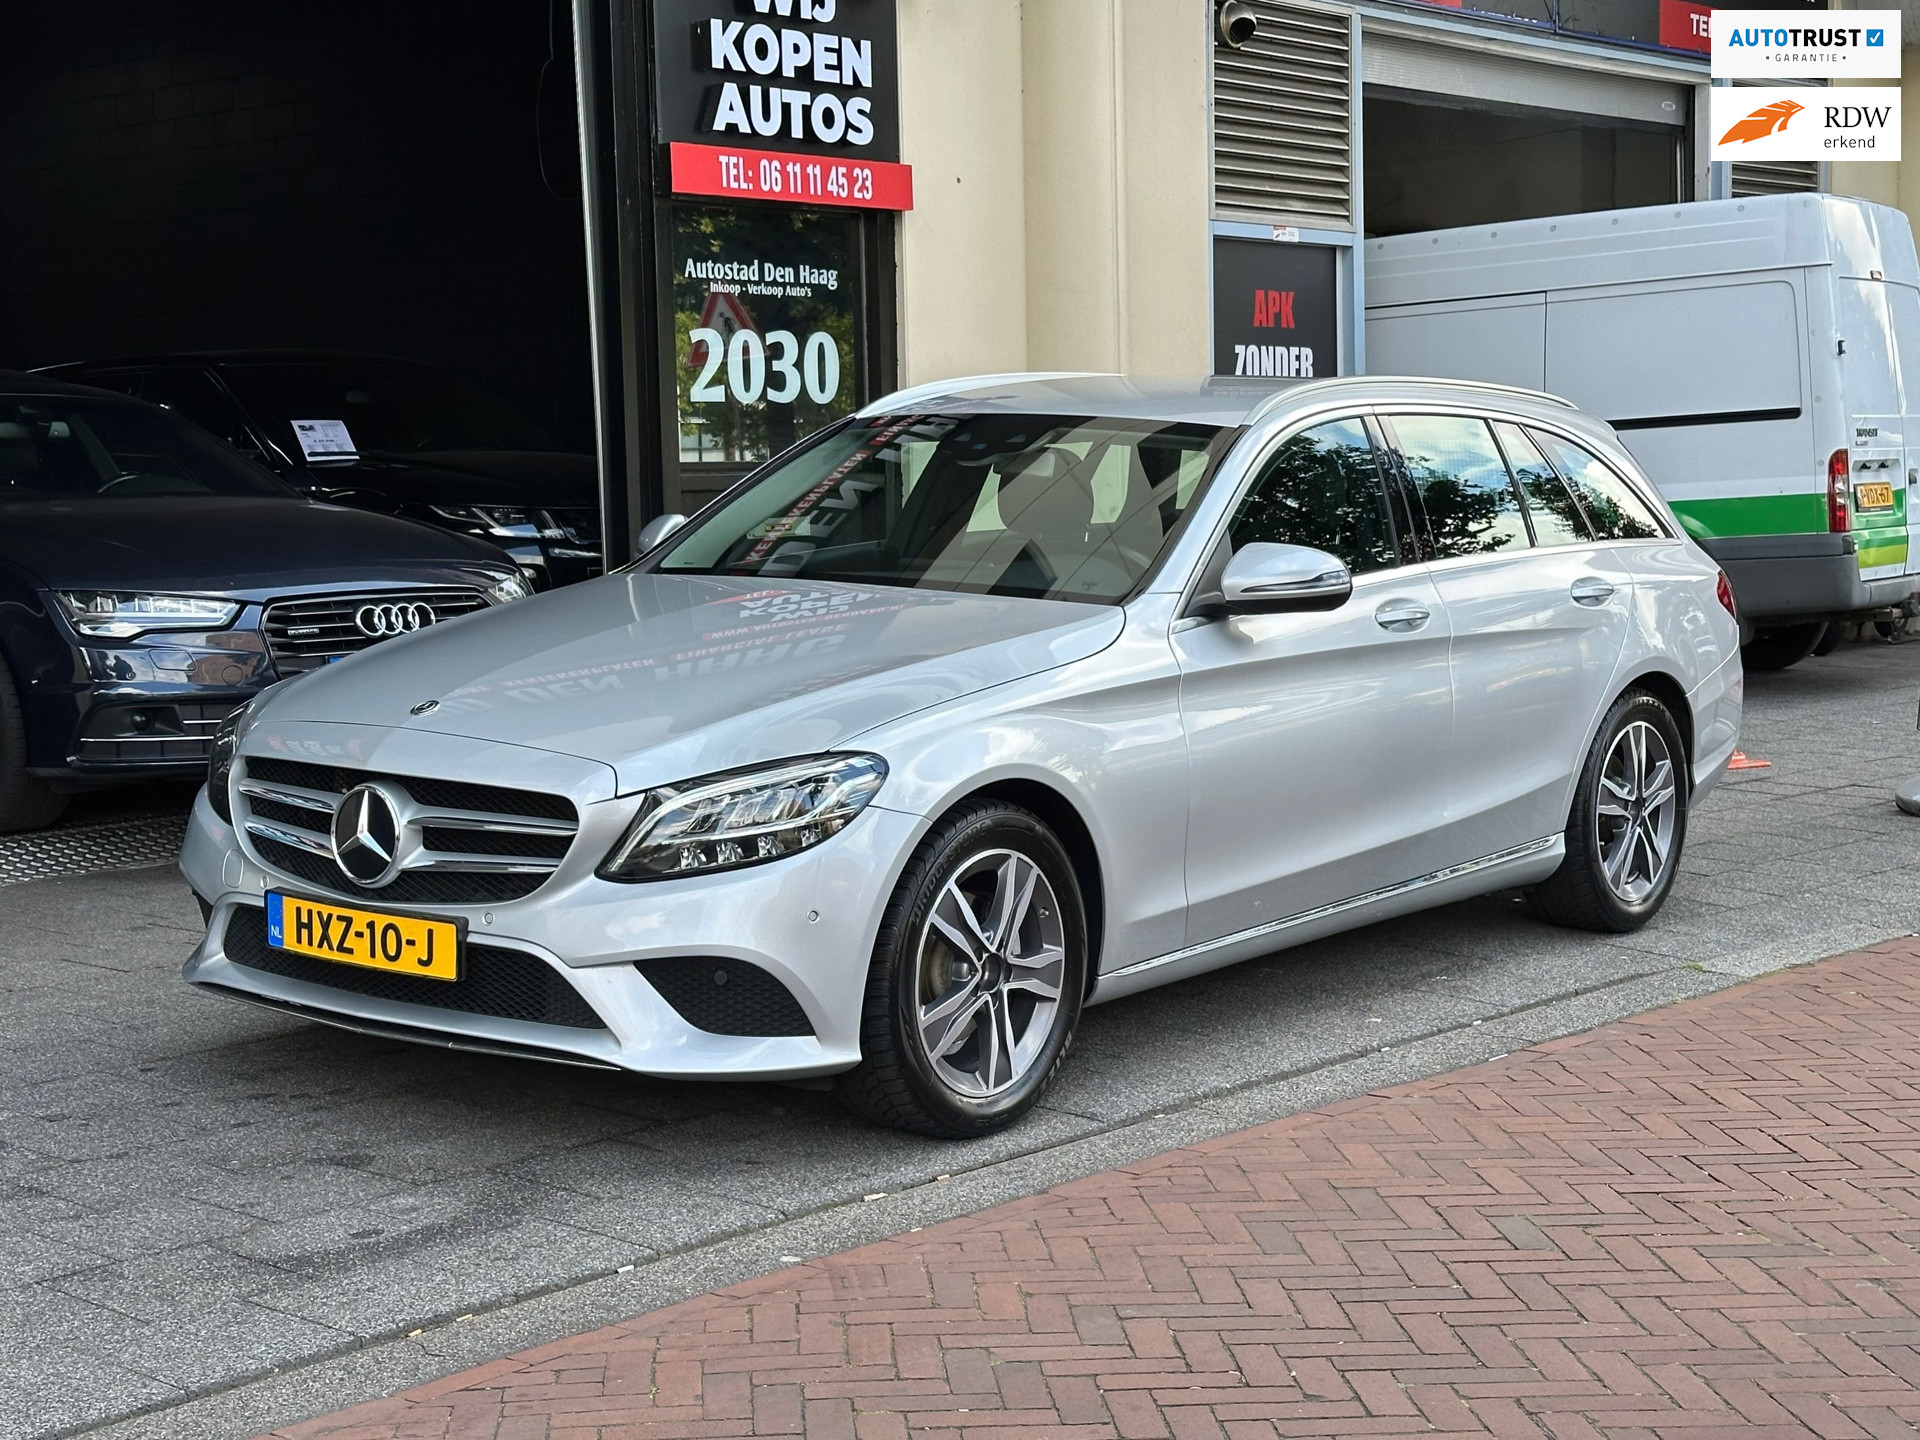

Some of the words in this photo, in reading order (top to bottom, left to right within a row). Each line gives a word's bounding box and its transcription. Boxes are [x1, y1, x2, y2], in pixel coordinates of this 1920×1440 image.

[710, 18, 873, 87] KOPEN
[713, 82, 874, 146] AUTOS
[719, 155, 753, 190] TEL:
[759, 159, 782, 193] 06
[787, 162, 802, 194] 11
[806, 164, 822, 196] 11
[827, 166, 848, 199] 45
[853, 168, 873, 200] 23
[684, 258, 759, 282] Autostad
[764, 262, 795, 283] Den
[799, 265, 838, 290] Haag
[710, 281, 741, 296] Inkoop
[747, 283, 784, 298] Verkoop
[785, 286, 812, 298] Auto's
[1253, 289, 1295, 329] APK
[689, 328, 840, 405] 2030
[1235, 344, 1314, 378] ZONDER
[270, 926, 282, 938] NL
[295, 906, 434, 967] HXZ-10-J
